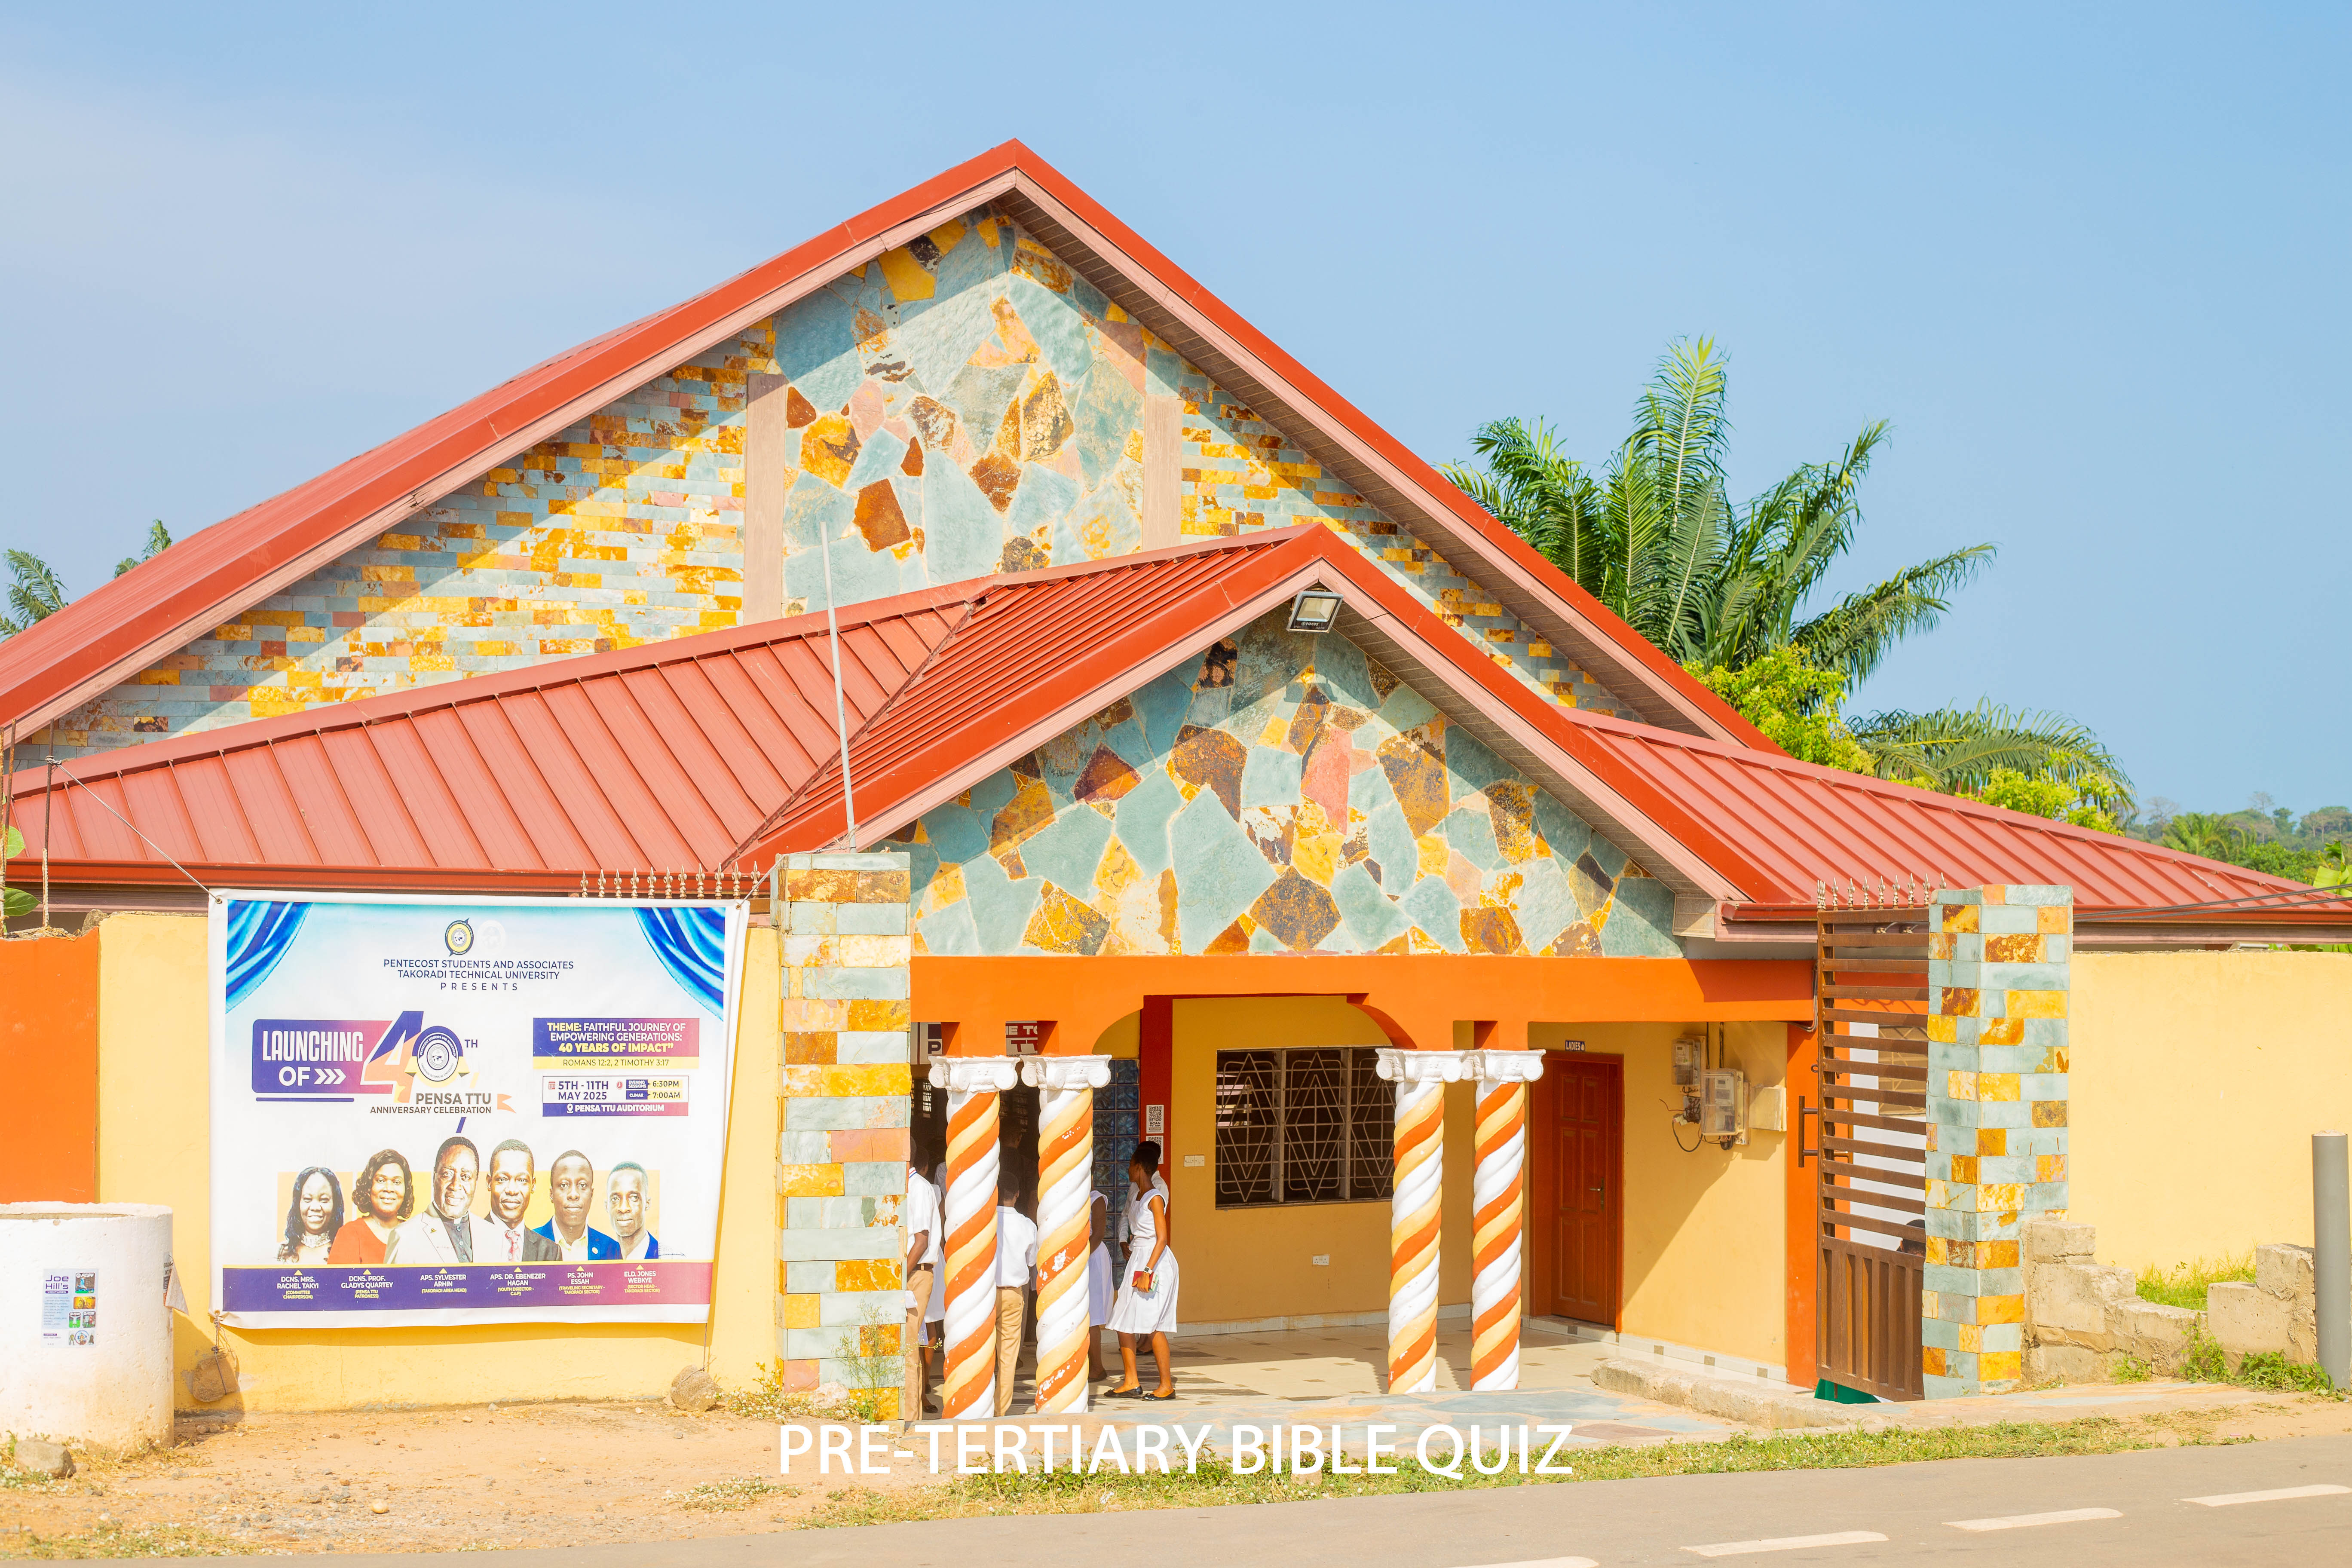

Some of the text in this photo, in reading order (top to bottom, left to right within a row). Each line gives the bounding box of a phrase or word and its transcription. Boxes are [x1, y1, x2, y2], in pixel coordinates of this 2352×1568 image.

[384, 959, 439, 968] PENTECOST
[442, 960, 490, 968] STUDENTS
[517, 961, 574, 969] ASSOCIATES
[398, 970, 560, 980] TAKORADI TECHNICAL UNIVERSITY
[441, 983, 518, 991] PRESENTS
[547, 1023, 686, 1032] THEME: FAITHFUL JOURNEY OF
[550, 1032, 683, 1041] EMPOWERING GENERATIONS:
[262, 1030, 364, 1062] LAUNCHING
[558, 1043, 573, 1053] 40
[575, 1043, 609, 1053] YEARS
[611, 1043, 626, 1053] OF
[1566, 1041, 1580, 1050] LADIES
[598, 1059, 612, 1067] 12:2,
[279, 1066, 311, 1086] OF
[558, 1081, 578, 1090] 5TH
[587, 1081, 609, 1090] 11TH
[416, 1093, 491, 1105] PENSA TTU
[558, 1091, 607, 1100] MAY 2025
[617, 1104, 665, 1112] AUDITORIUM
